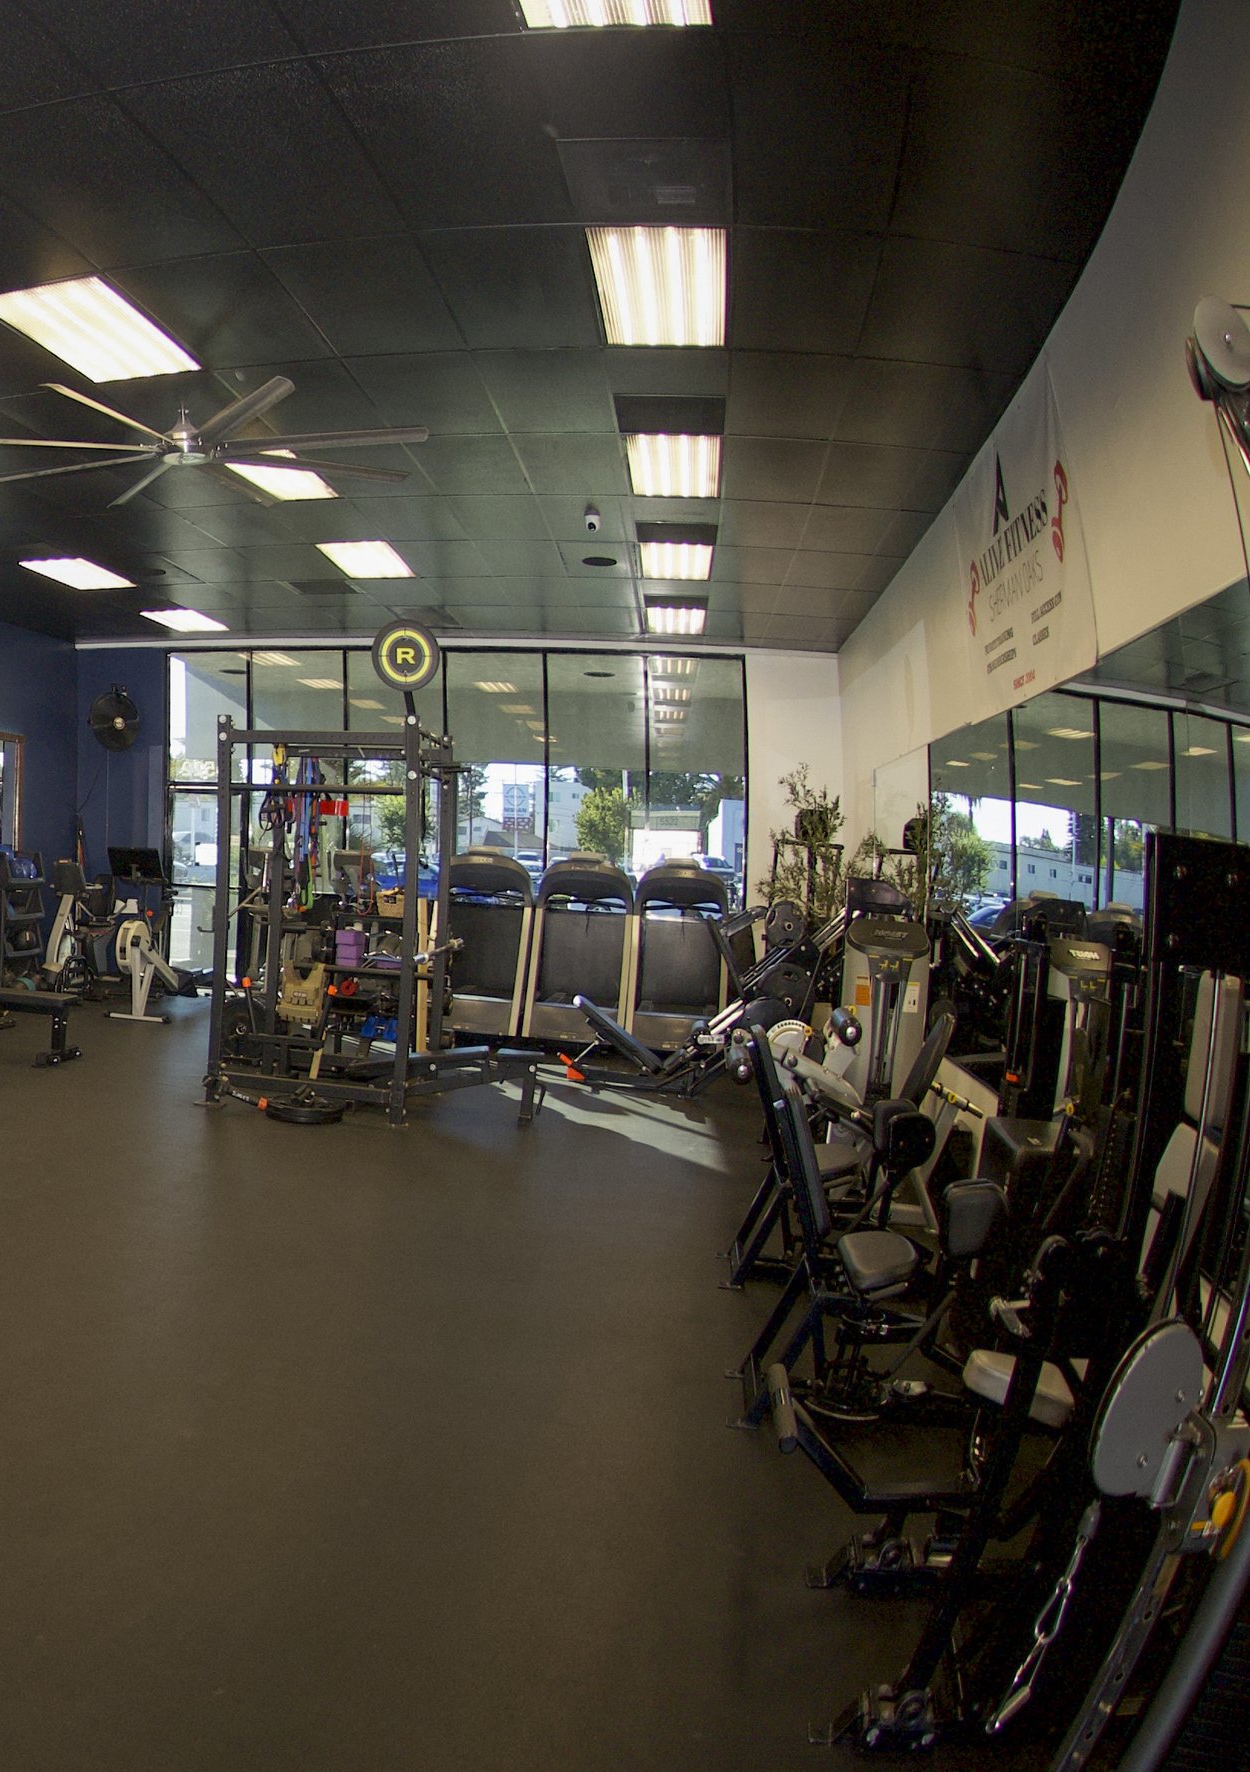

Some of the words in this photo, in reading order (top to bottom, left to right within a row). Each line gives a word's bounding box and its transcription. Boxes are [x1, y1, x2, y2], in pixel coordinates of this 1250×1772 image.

[979, 534, 1006, 587] ALIVE
[1003, 488, 1048, 563] FITNESS
[396, 647, 416, 664] R
